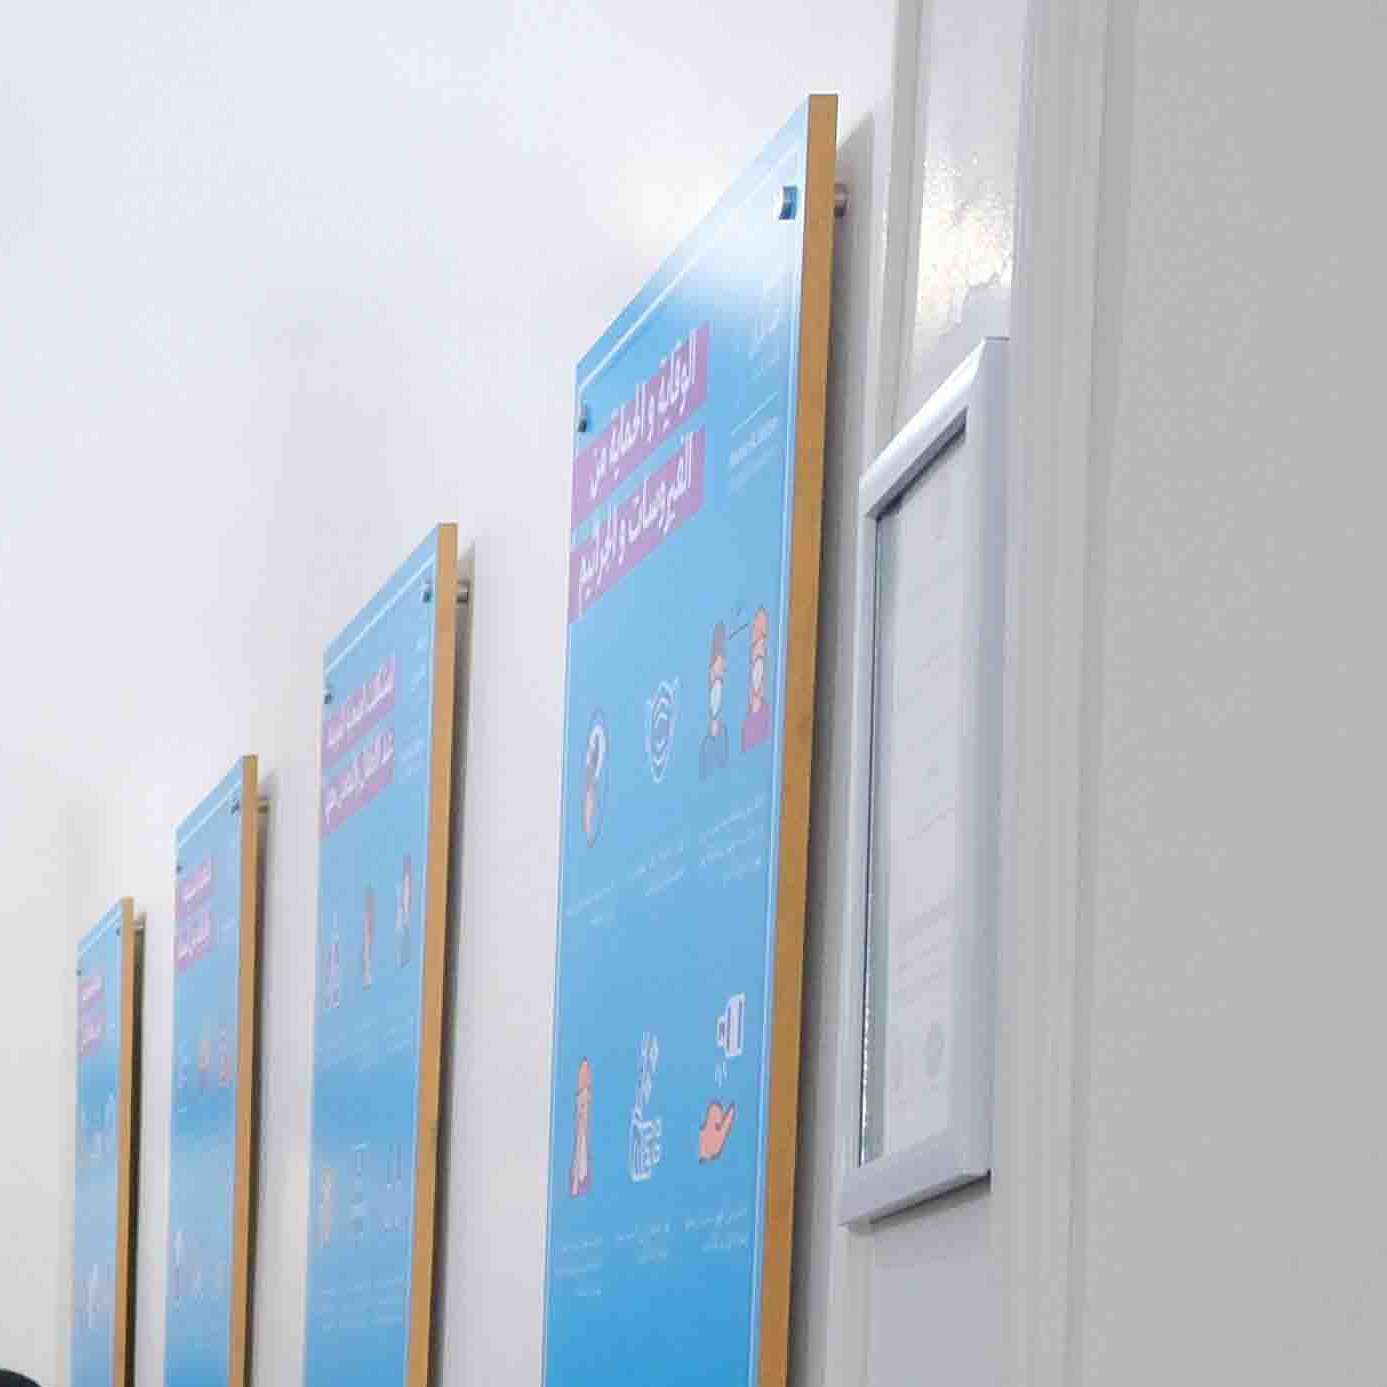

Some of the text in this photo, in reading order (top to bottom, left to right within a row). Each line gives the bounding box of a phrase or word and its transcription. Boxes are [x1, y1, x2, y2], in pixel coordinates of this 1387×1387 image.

[589, 329, 698, 499] الوقاية و الحماية من
[628, 430, 693, 542] الفيروسات
[579, 511, 616, 618] الجراثيم
